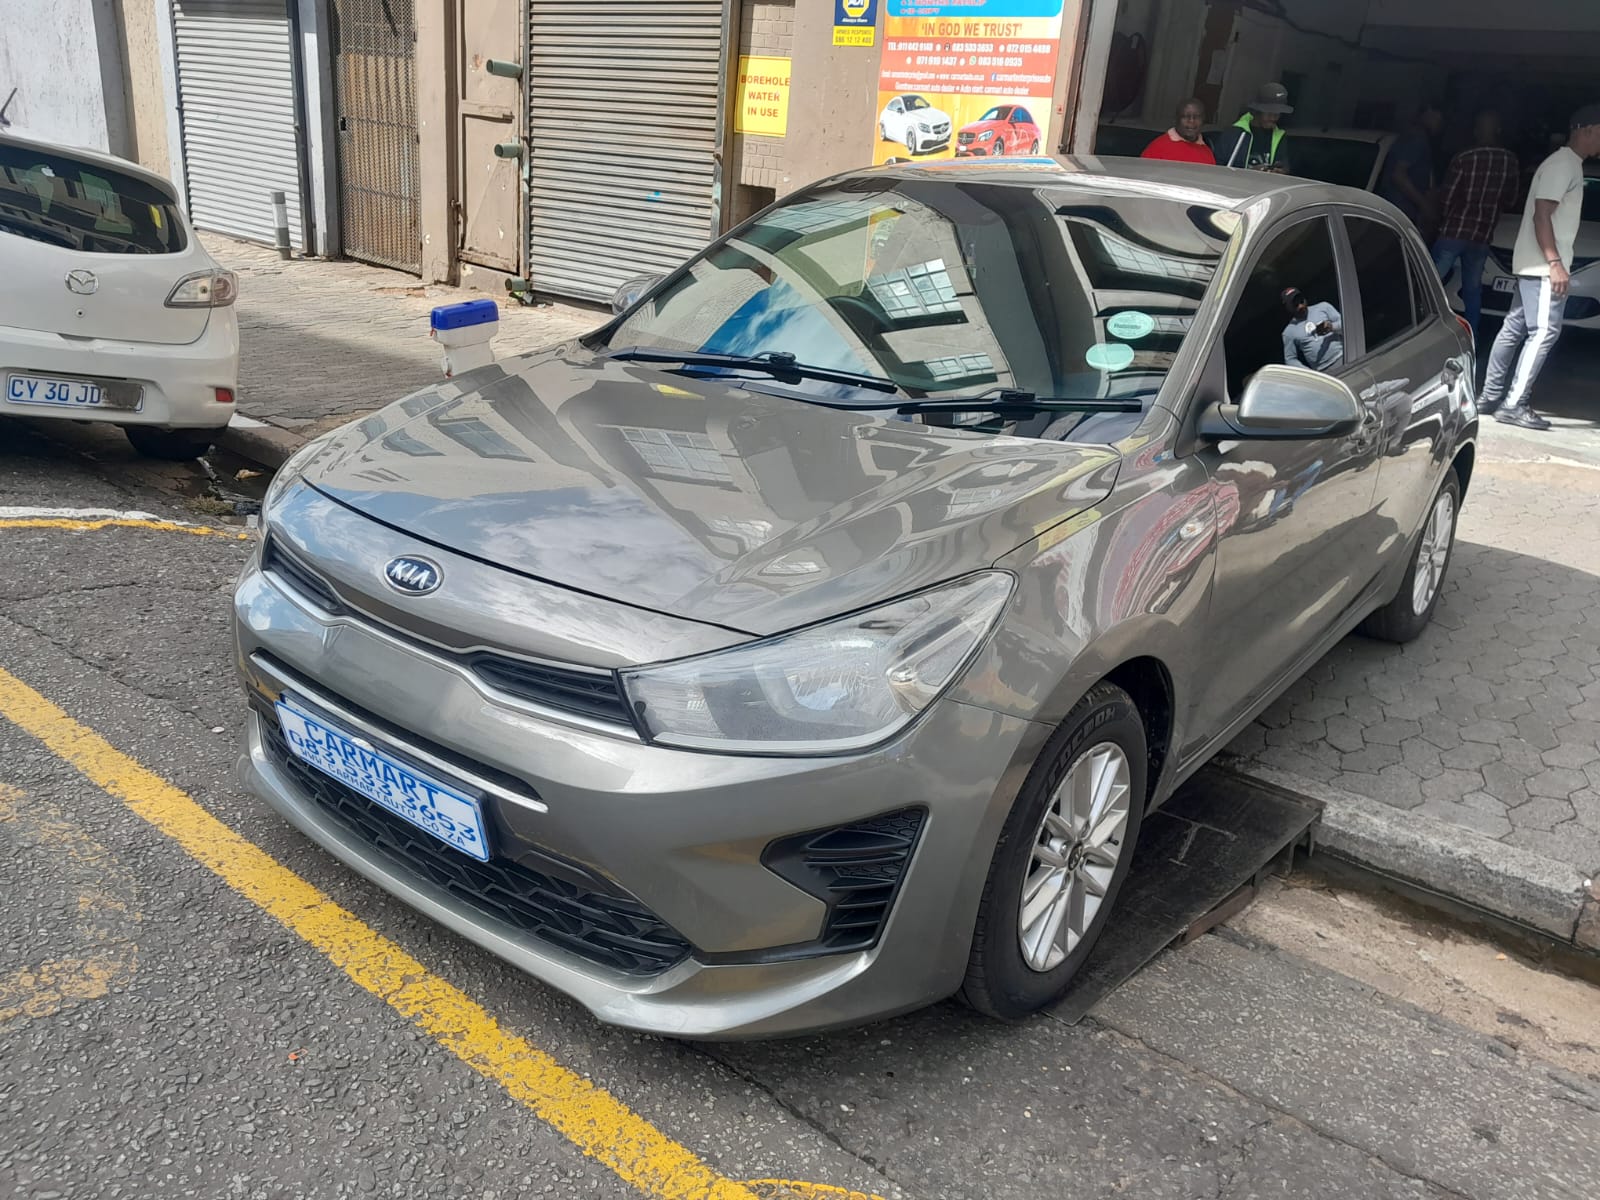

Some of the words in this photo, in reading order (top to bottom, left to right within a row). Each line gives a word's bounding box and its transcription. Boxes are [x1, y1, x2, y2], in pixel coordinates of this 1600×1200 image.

[938, 22, 961, 36] GOD
[963, 23, 980, 37] WE
[741, 74, 791, 87] BOREHOLE
[748, 91, 780, 102] WATER
[747, 106, 758, 116] IN
[760, 107, 779, 118] USE
[10, 378, 39, 399] CY
[44, 381, 70, 401] 30
[75, 385, 101, 404] JD
[389, 559, 431, 590] KIA
[304, 720, 439, 809] CARMART
[289, 729, 336, 765] 083
[341, 758, 393, 797] 533
[400, 791, 477, 842] 3653
